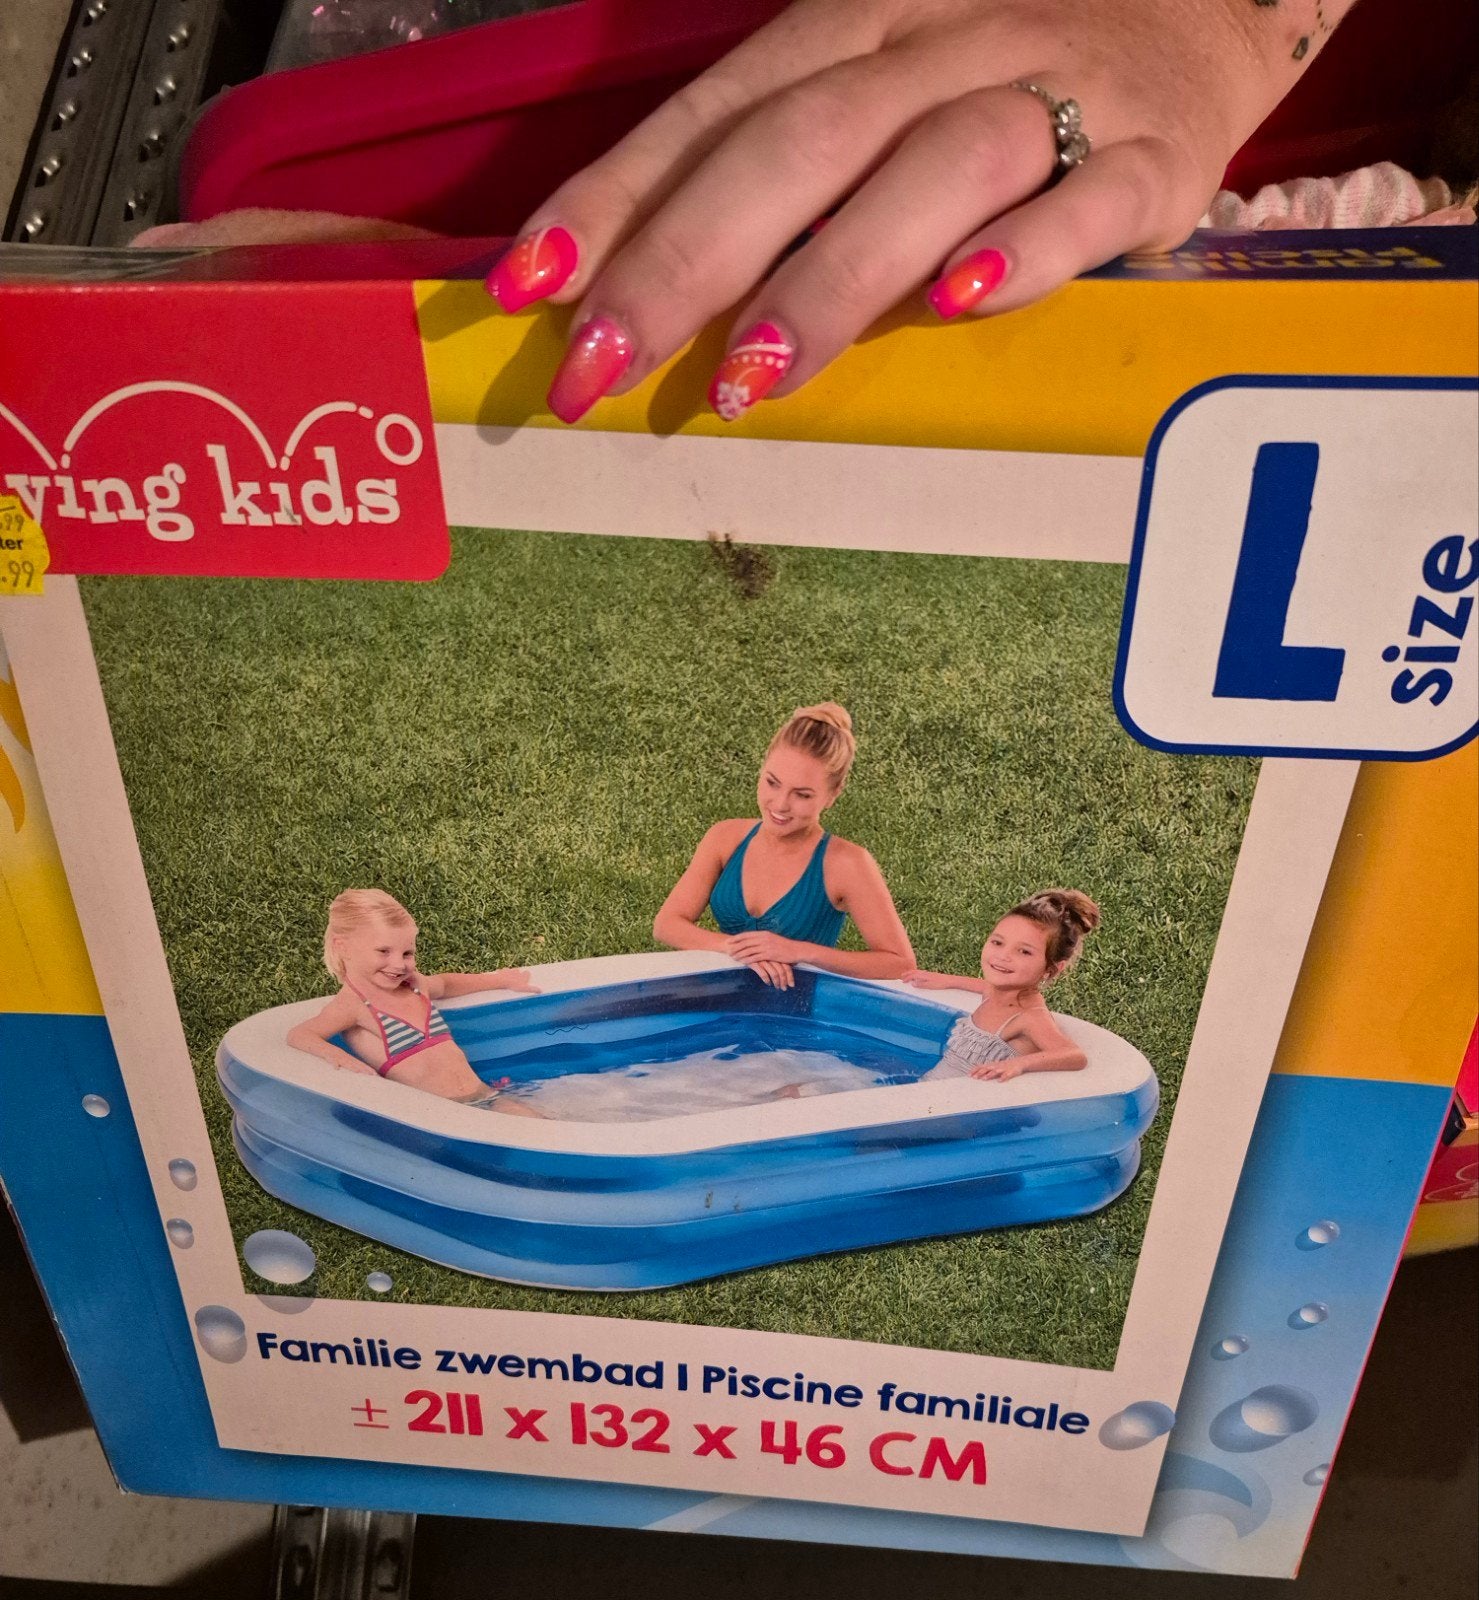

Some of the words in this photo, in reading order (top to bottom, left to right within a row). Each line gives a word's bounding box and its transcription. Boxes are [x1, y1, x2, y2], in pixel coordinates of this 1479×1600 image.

[206, 443, 401, 527] kids
[1212, 441, 1346, 702] L
[1381, 535, 1479, 707] size
[256, 1332, 422, 1372] Familie
[435, 1350, 665, 1391] zwembad
[702, 1365, 863, 1408] Piscine
[876, 1382, 1091, 1435] familiale
[403, 1388, 484, 1437] 211
[569, 1401, 671, 1455] 132
[760, 1419, 847, 1470] 46
[868, 1431, 988, 1486] CM
